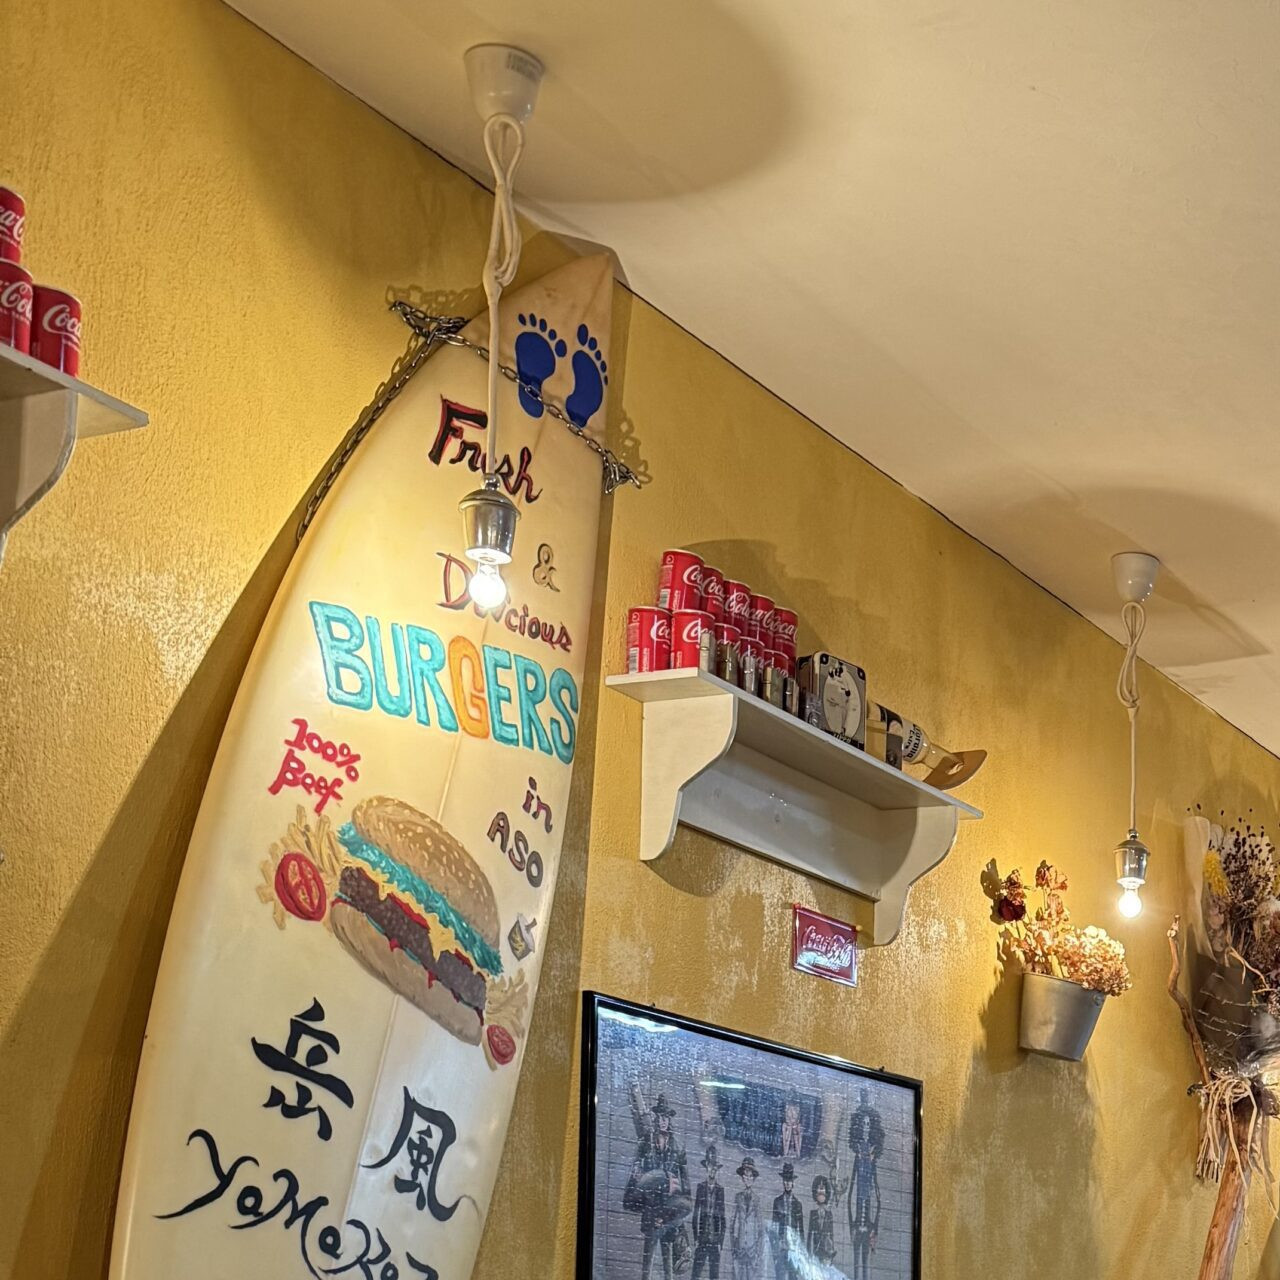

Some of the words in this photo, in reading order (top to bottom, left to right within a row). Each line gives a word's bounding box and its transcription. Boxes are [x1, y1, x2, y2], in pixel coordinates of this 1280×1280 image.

[428, 394, 543, 503] Frsh
[437, 552, 573, 652] Dcious
[533, 543, 560, 592] &
[309, 600, 579, 764] BURGERS
[268, 749, 344, 816] Beef
[285, 718, 361, 782] 100%
[522, 776, 553, 833] in
[486, 811, 544, 888] ASO
